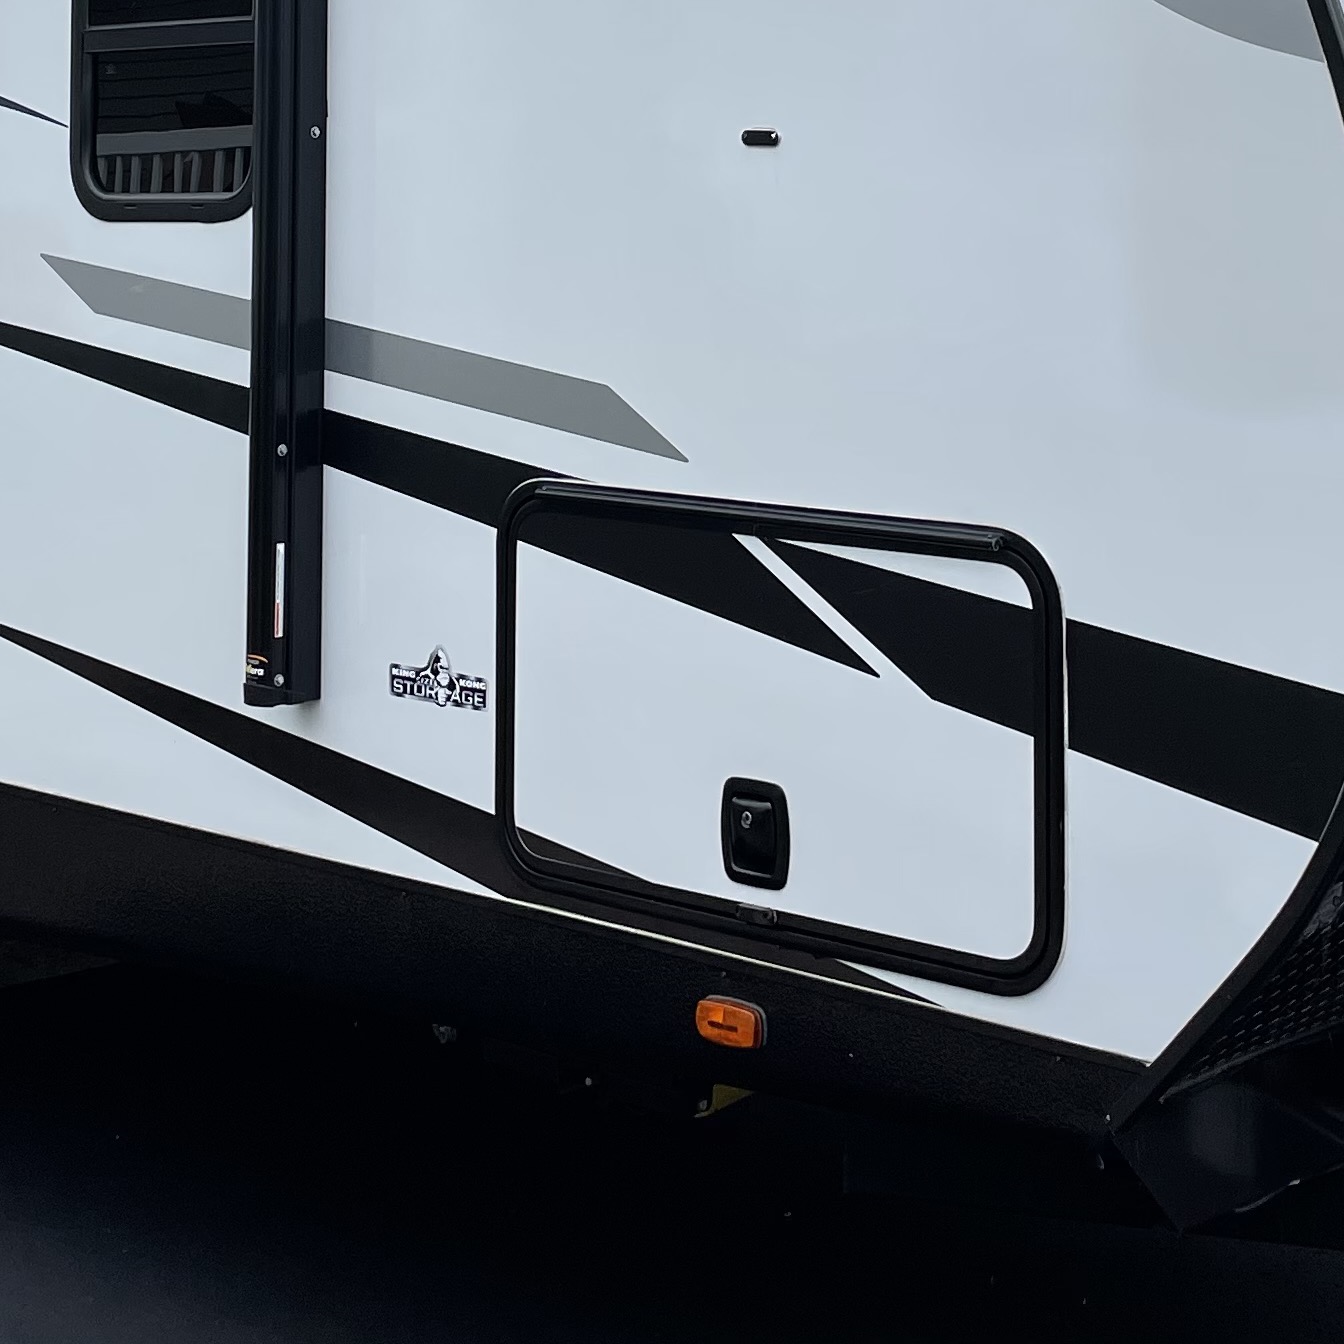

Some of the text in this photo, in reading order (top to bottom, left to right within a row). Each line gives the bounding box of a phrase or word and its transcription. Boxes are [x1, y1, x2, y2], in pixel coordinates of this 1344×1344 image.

[391, 667, 487, 690] KING KONG
[393, 678, 485, 707] STORAGE
